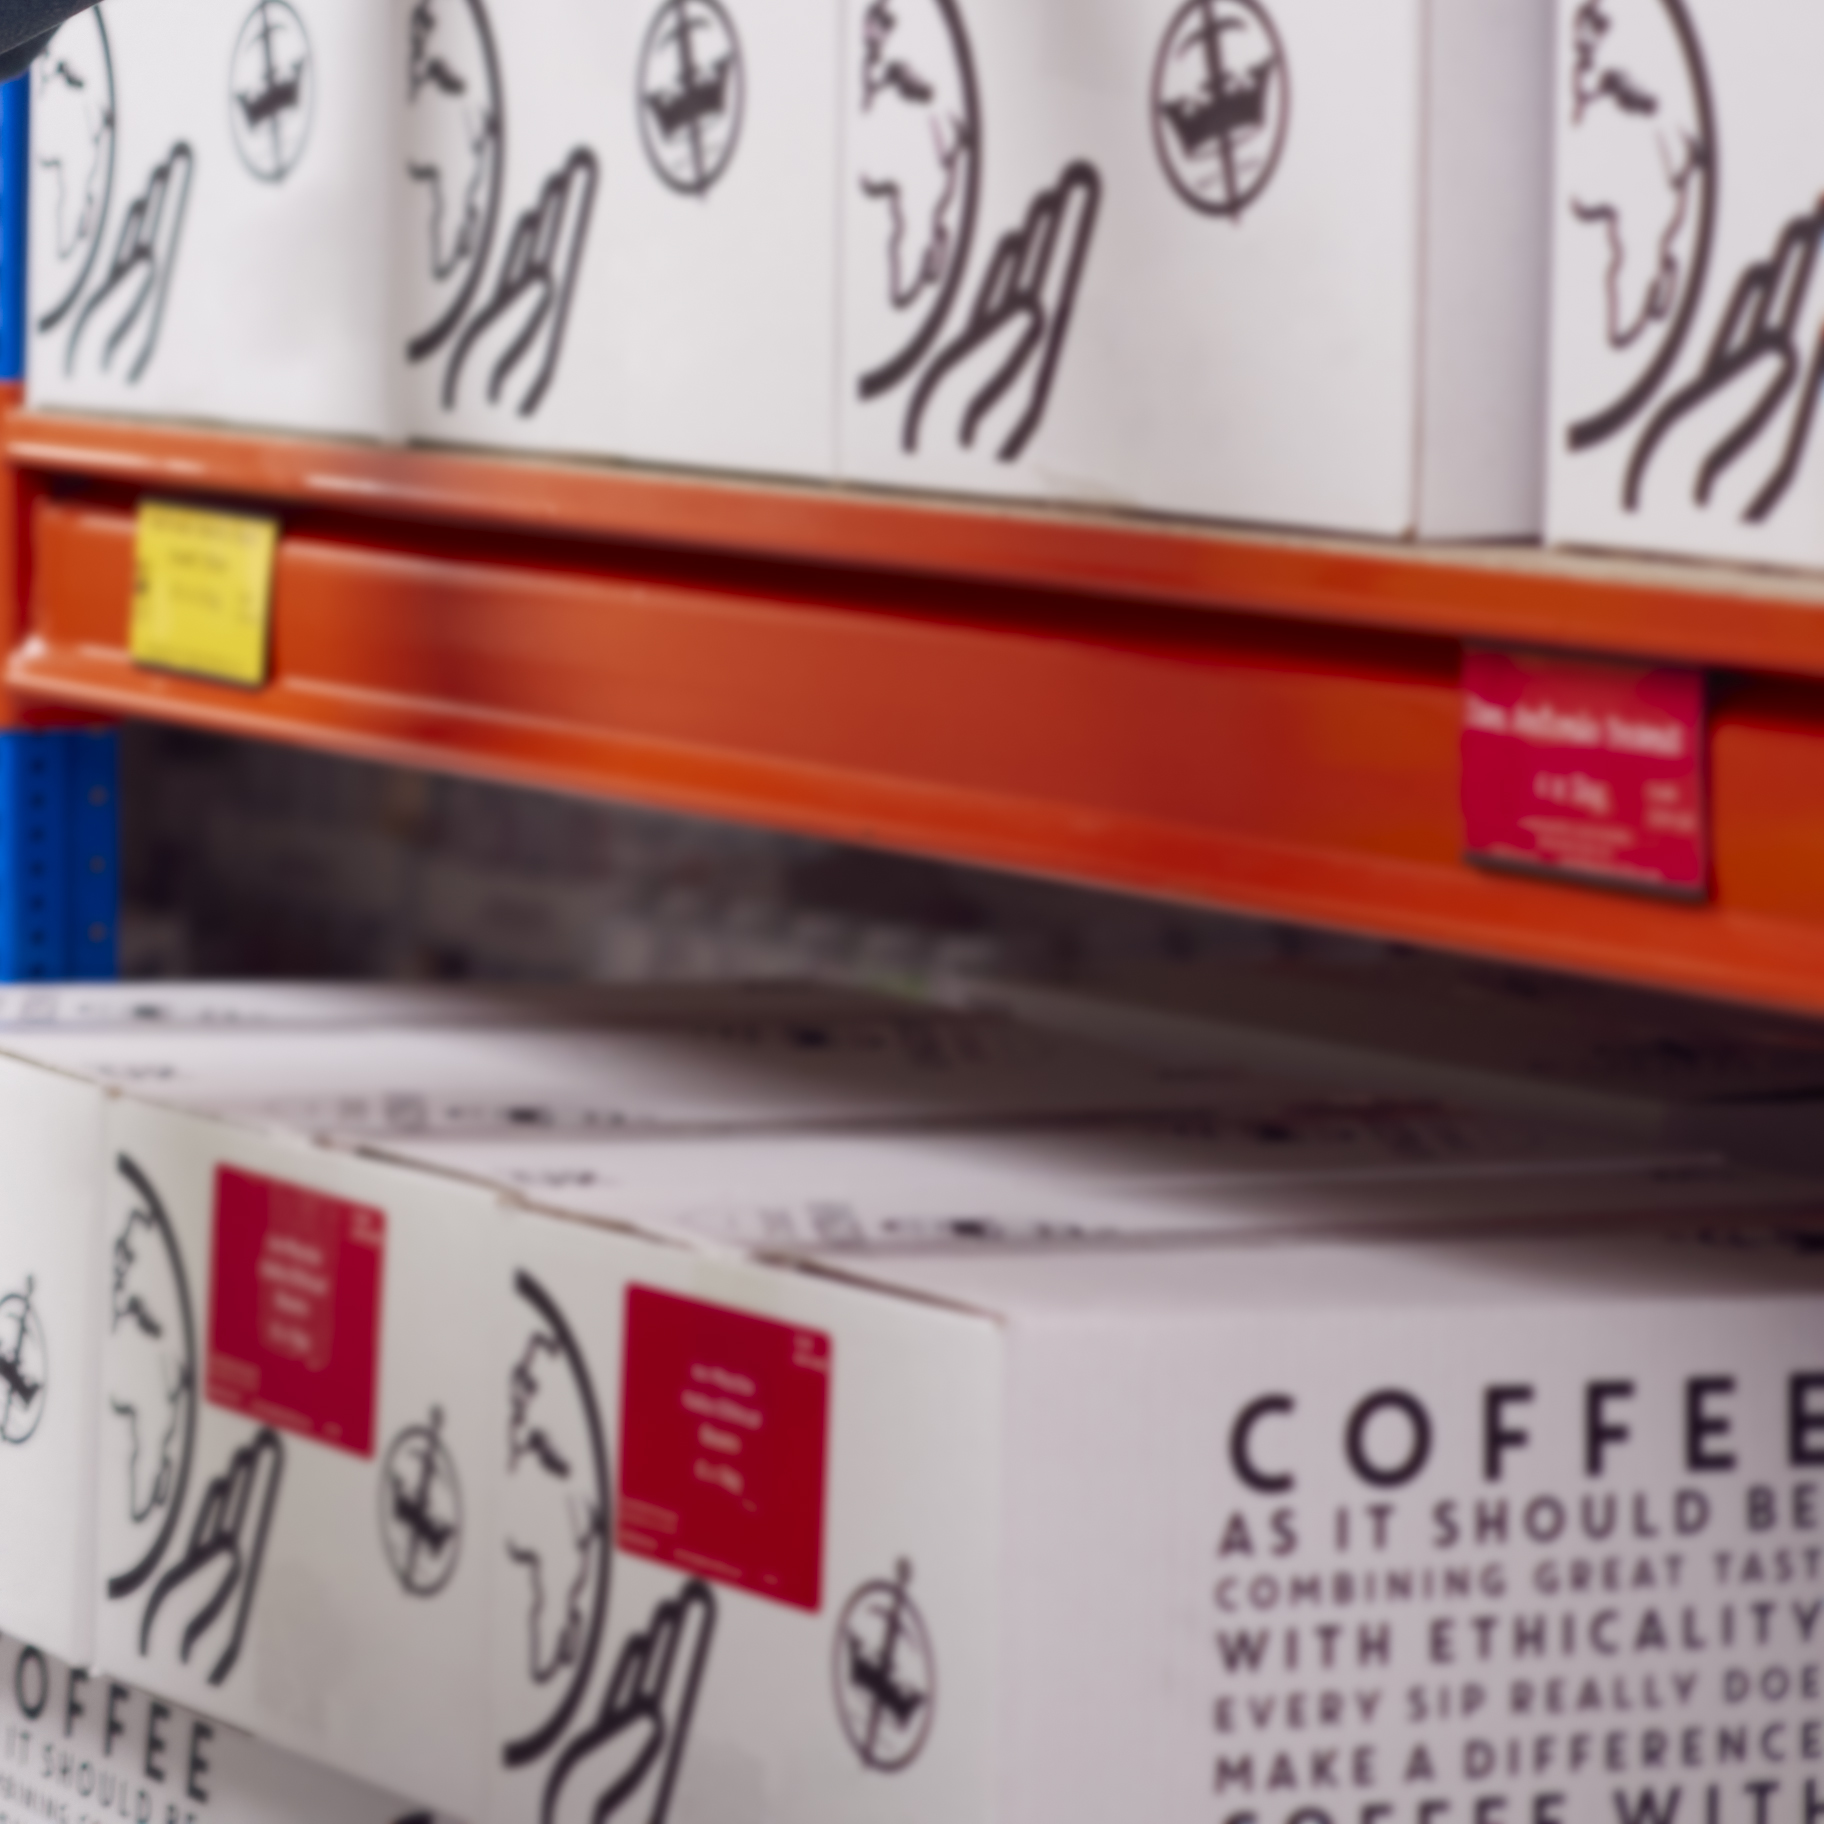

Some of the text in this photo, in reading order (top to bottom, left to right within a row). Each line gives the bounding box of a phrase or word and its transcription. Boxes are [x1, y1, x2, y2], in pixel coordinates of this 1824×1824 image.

[1228, 1370, 1824, 1495] COFFEE
[1219, 1509, 1298, 1558] AS
[1335, 1502, 1394, 1552] IT
[1432, 1486, 1711, 1550] SHOULD
[1214, 1546, 1824, 1612] COMBINING GREAT TAST
[1216, 1621, 1392, 1674] WITH
[1214, 1665, 1823, 1733] EVERY SIP REALLY DOE
[1214, 1744, 1375, 1796] MAKE
[1404, 1742, 1435, 1783] A
